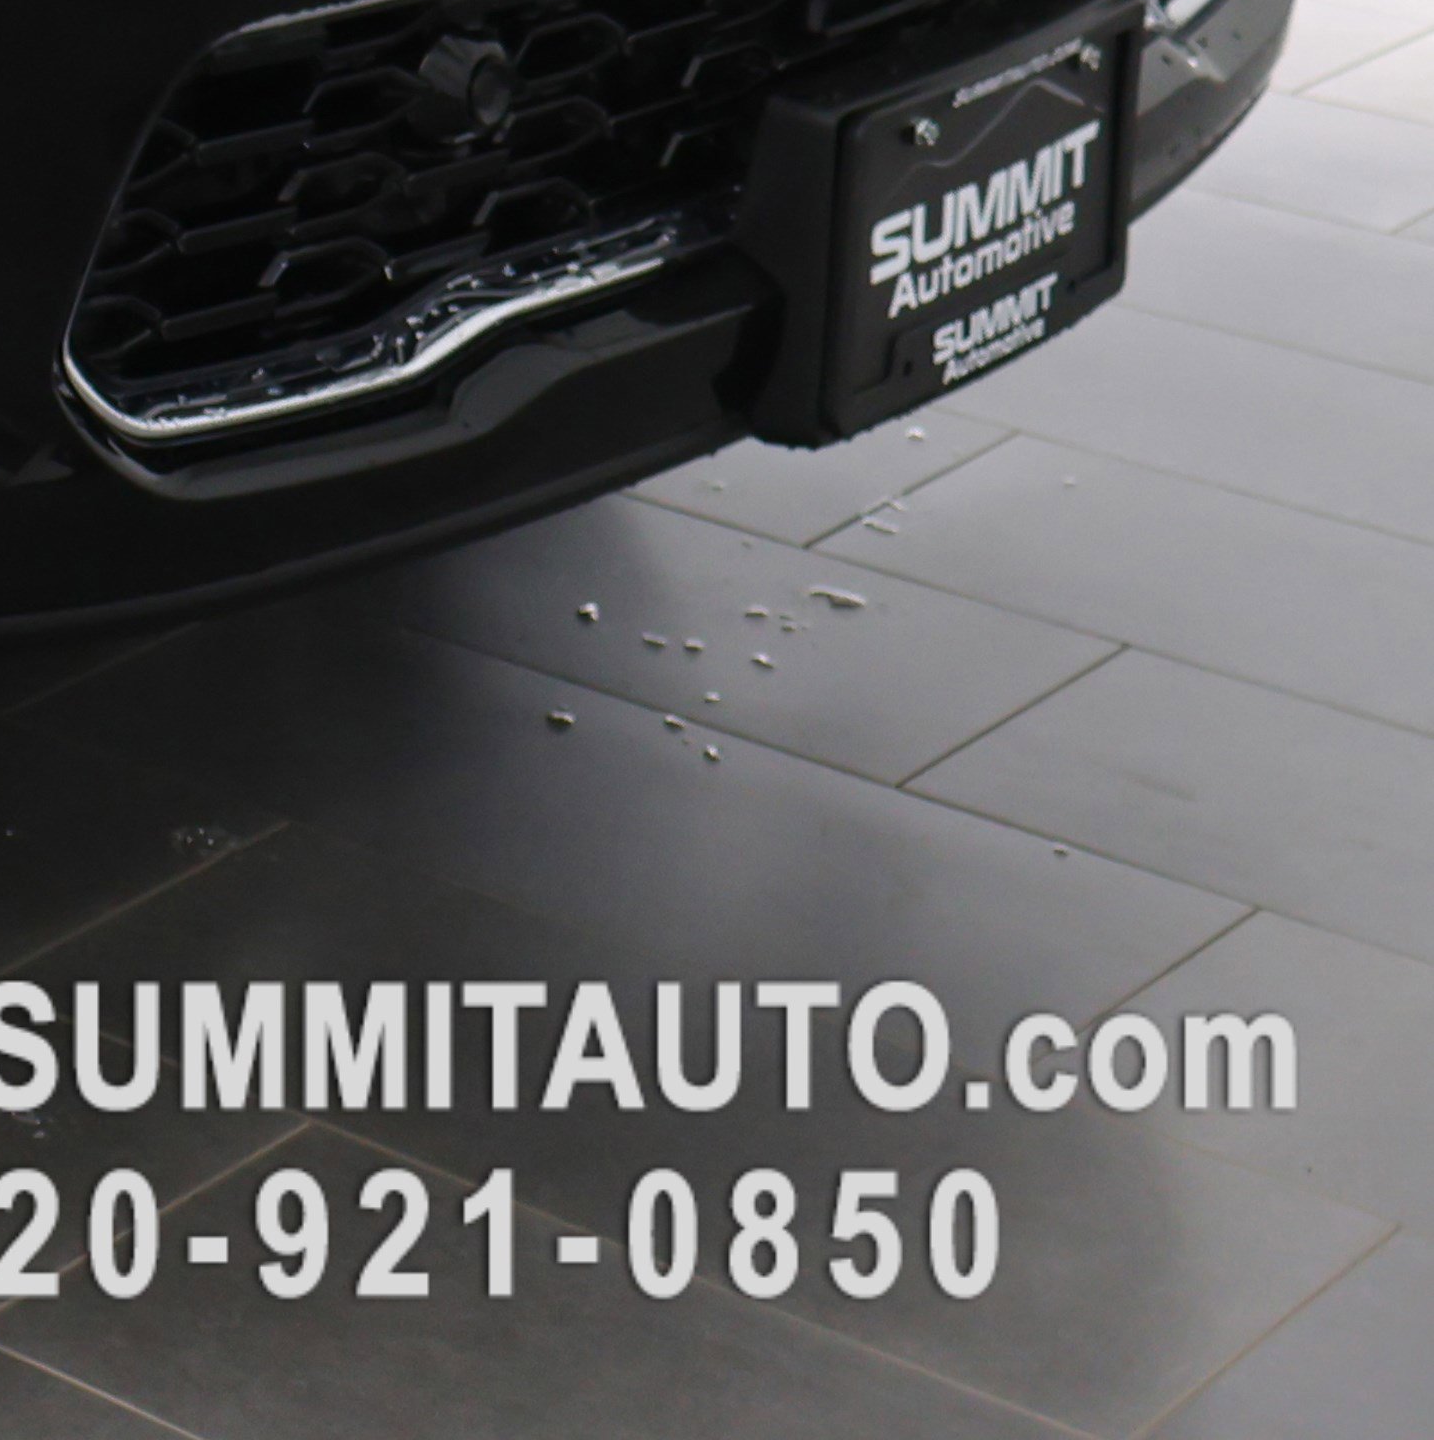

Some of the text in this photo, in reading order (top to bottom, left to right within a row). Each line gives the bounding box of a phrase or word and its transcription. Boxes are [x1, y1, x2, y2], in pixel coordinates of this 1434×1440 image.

[869, 120, 1101, 286] SUMMIT
[888, 200, 1077, 319] Automotive
[932, 272, 1060, 366] SUMMIT
